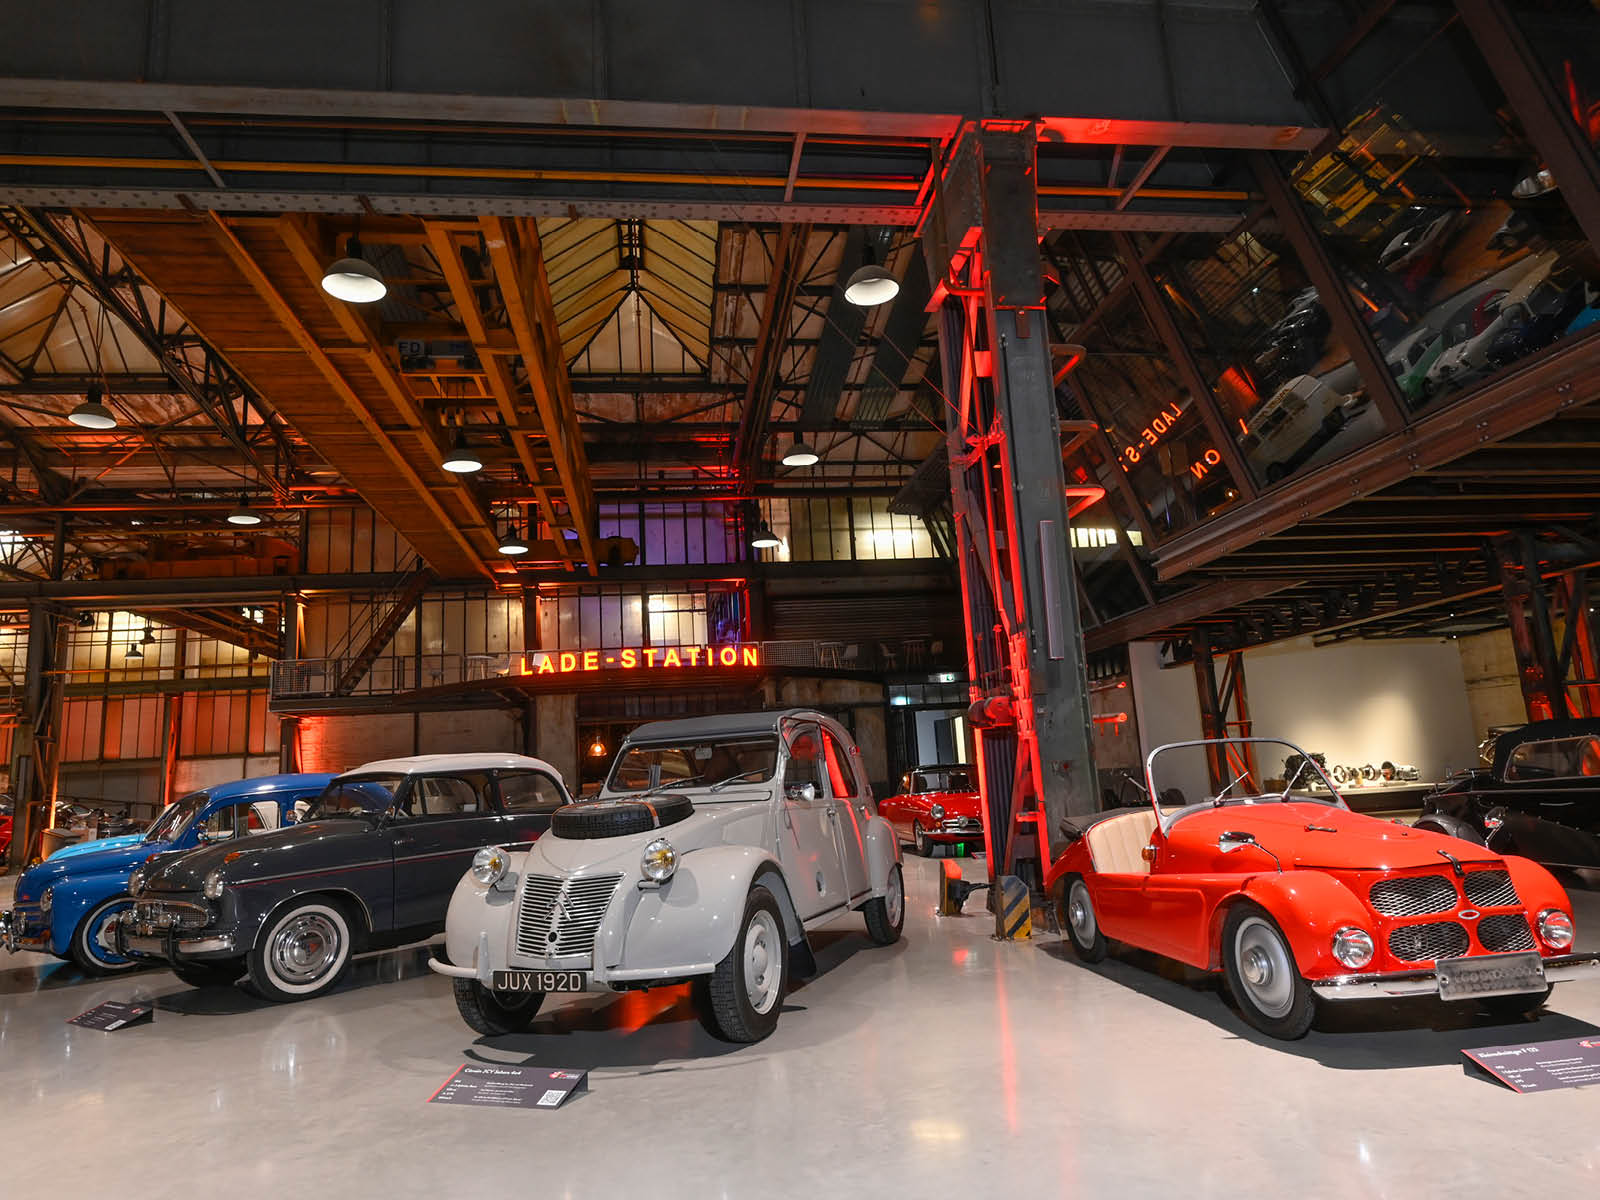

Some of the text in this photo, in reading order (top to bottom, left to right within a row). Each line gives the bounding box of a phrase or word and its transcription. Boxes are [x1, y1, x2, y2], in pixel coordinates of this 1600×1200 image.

[520, 647, 758, 676] LADE-STATION
[498, 972, 581, 991] JUX 192D
